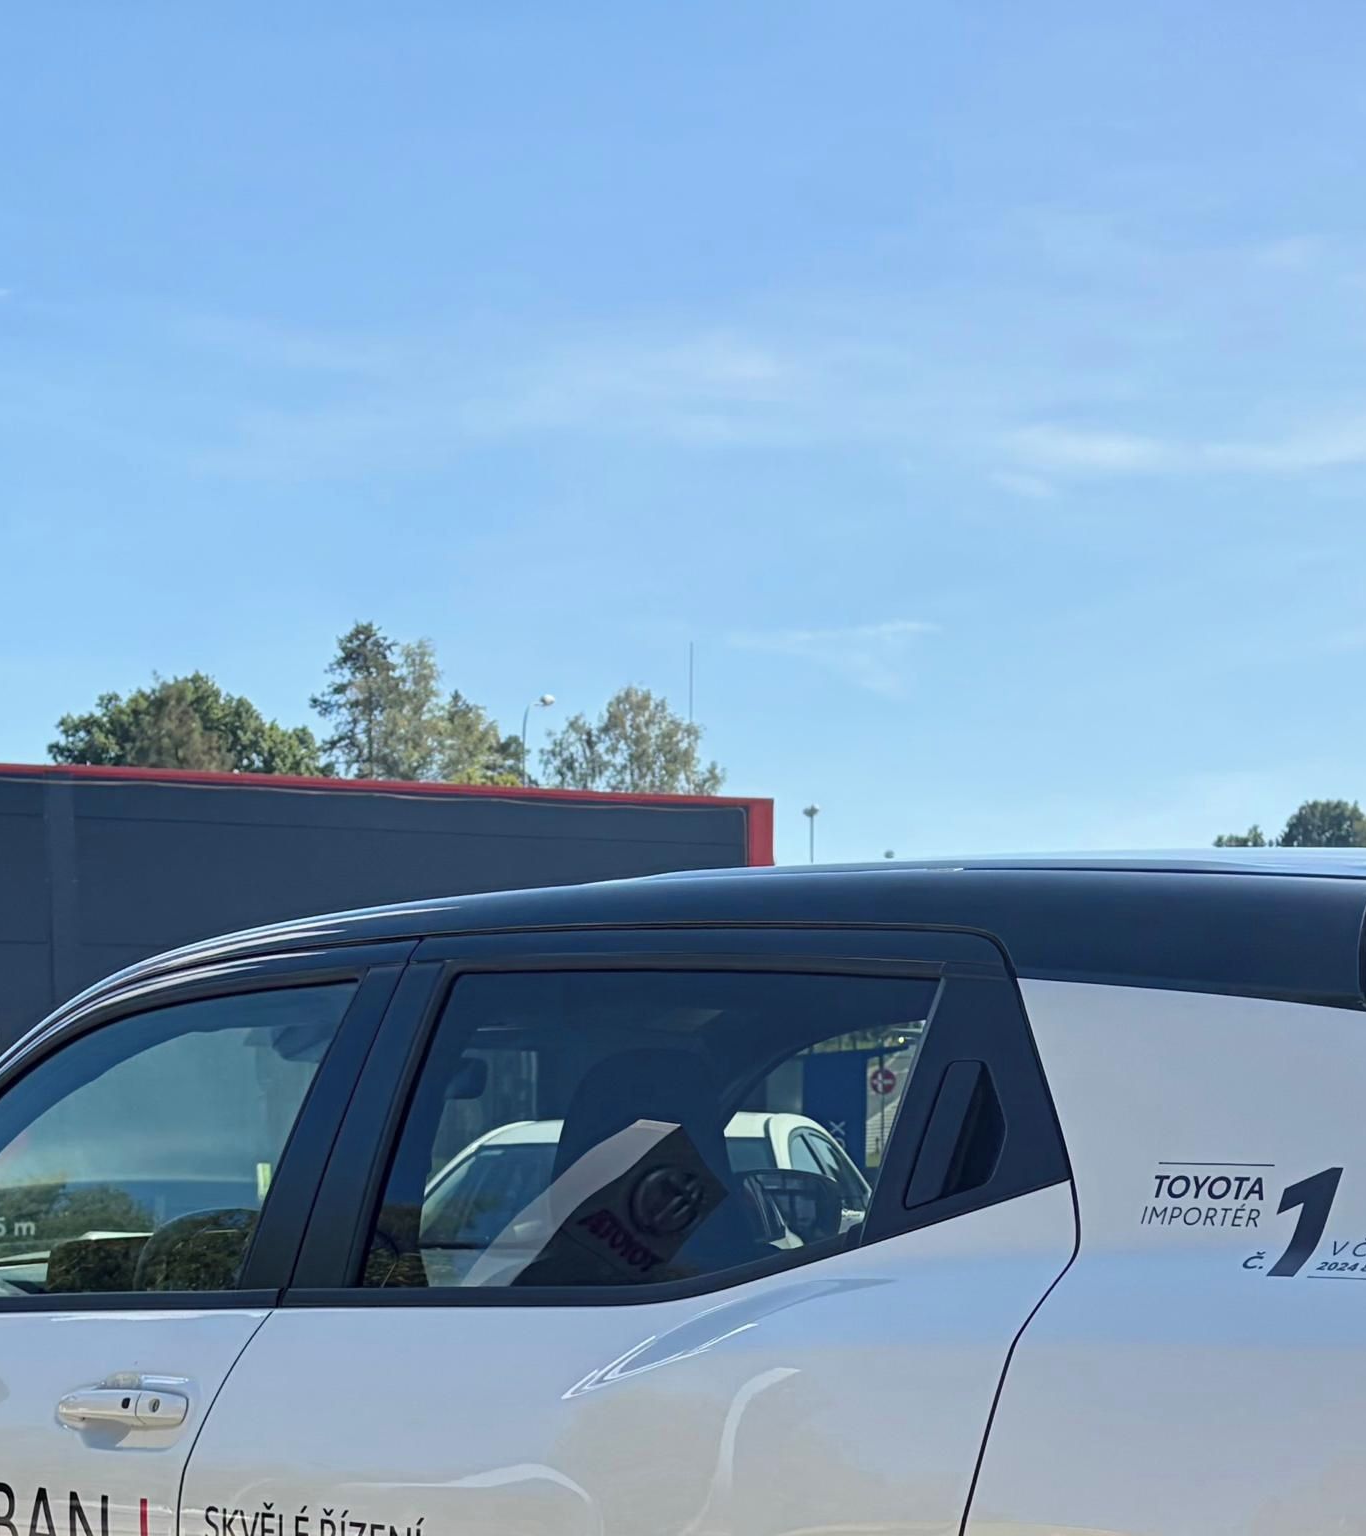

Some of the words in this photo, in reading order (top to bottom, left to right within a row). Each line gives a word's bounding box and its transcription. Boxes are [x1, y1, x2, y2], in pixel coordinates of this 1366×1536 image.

[1153, 1174, 1265, 1201] TOYOTA
[1139, 1203, 1262, 1229] IMPORTÉR
[13, 1220, 36, 1236] m
[1332, 1240, 1349, 1257] V
[1315, 1261, 1359, 1273] 2024
